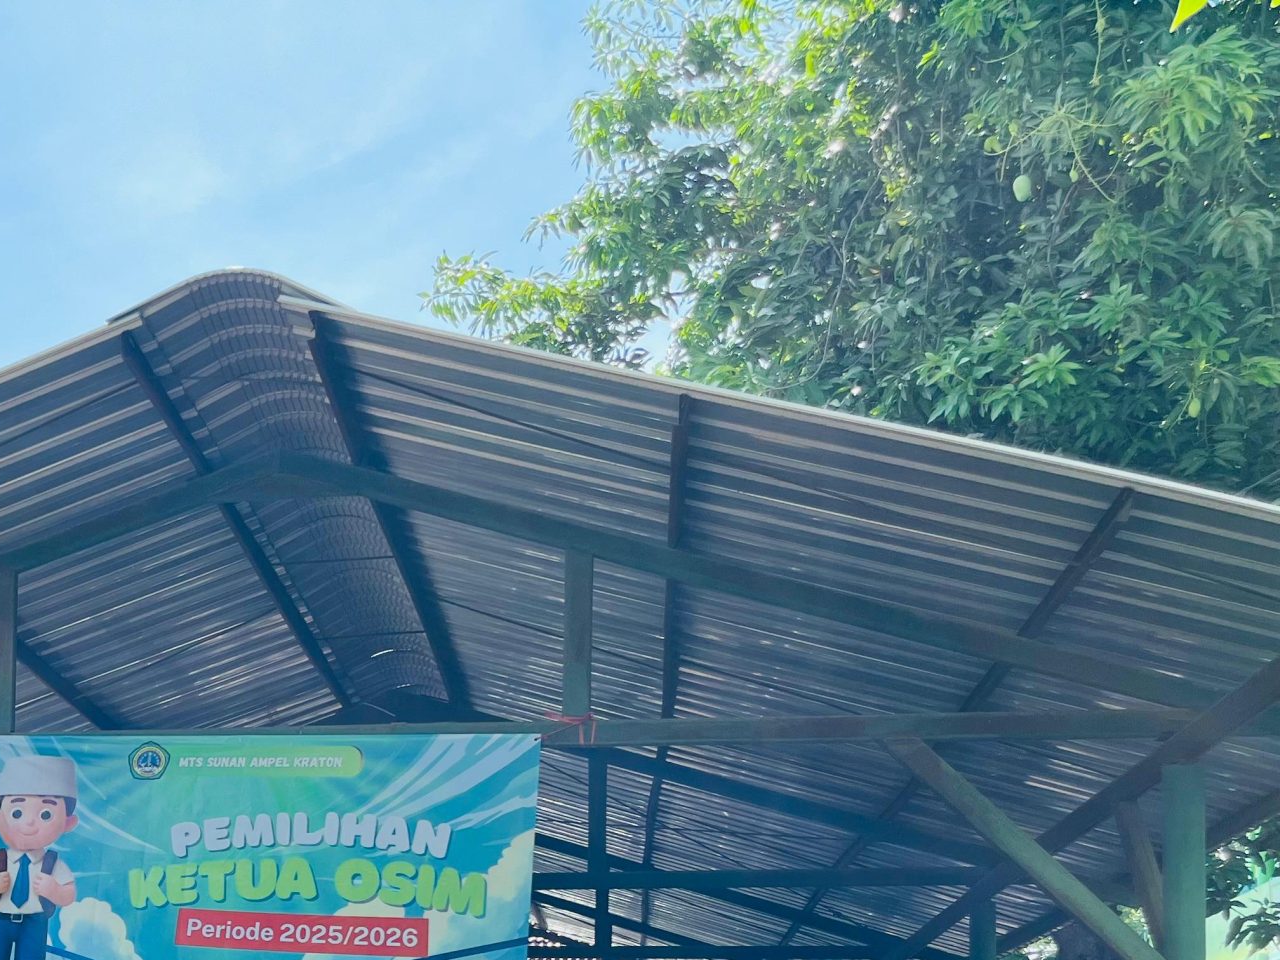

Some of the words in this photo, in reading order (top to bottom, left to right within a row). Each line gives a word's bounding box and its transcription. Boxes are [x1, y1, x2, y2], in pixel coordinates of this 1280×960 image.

[179, 757, 204, 768] MTS
[207, 757, 246, 768] SUNAN
[250, 757, 290, 768] AMPEL
[293, 757, 343, 768] KRATON
[171, 811, 452, 859] PEMILIHAN
[128, 857, 318, 910] KETUA
[334, 858, 488, 918] OSIM
[186, 918, 274, 943] Periode
[279, 924, 418, 949] 2025/2026
